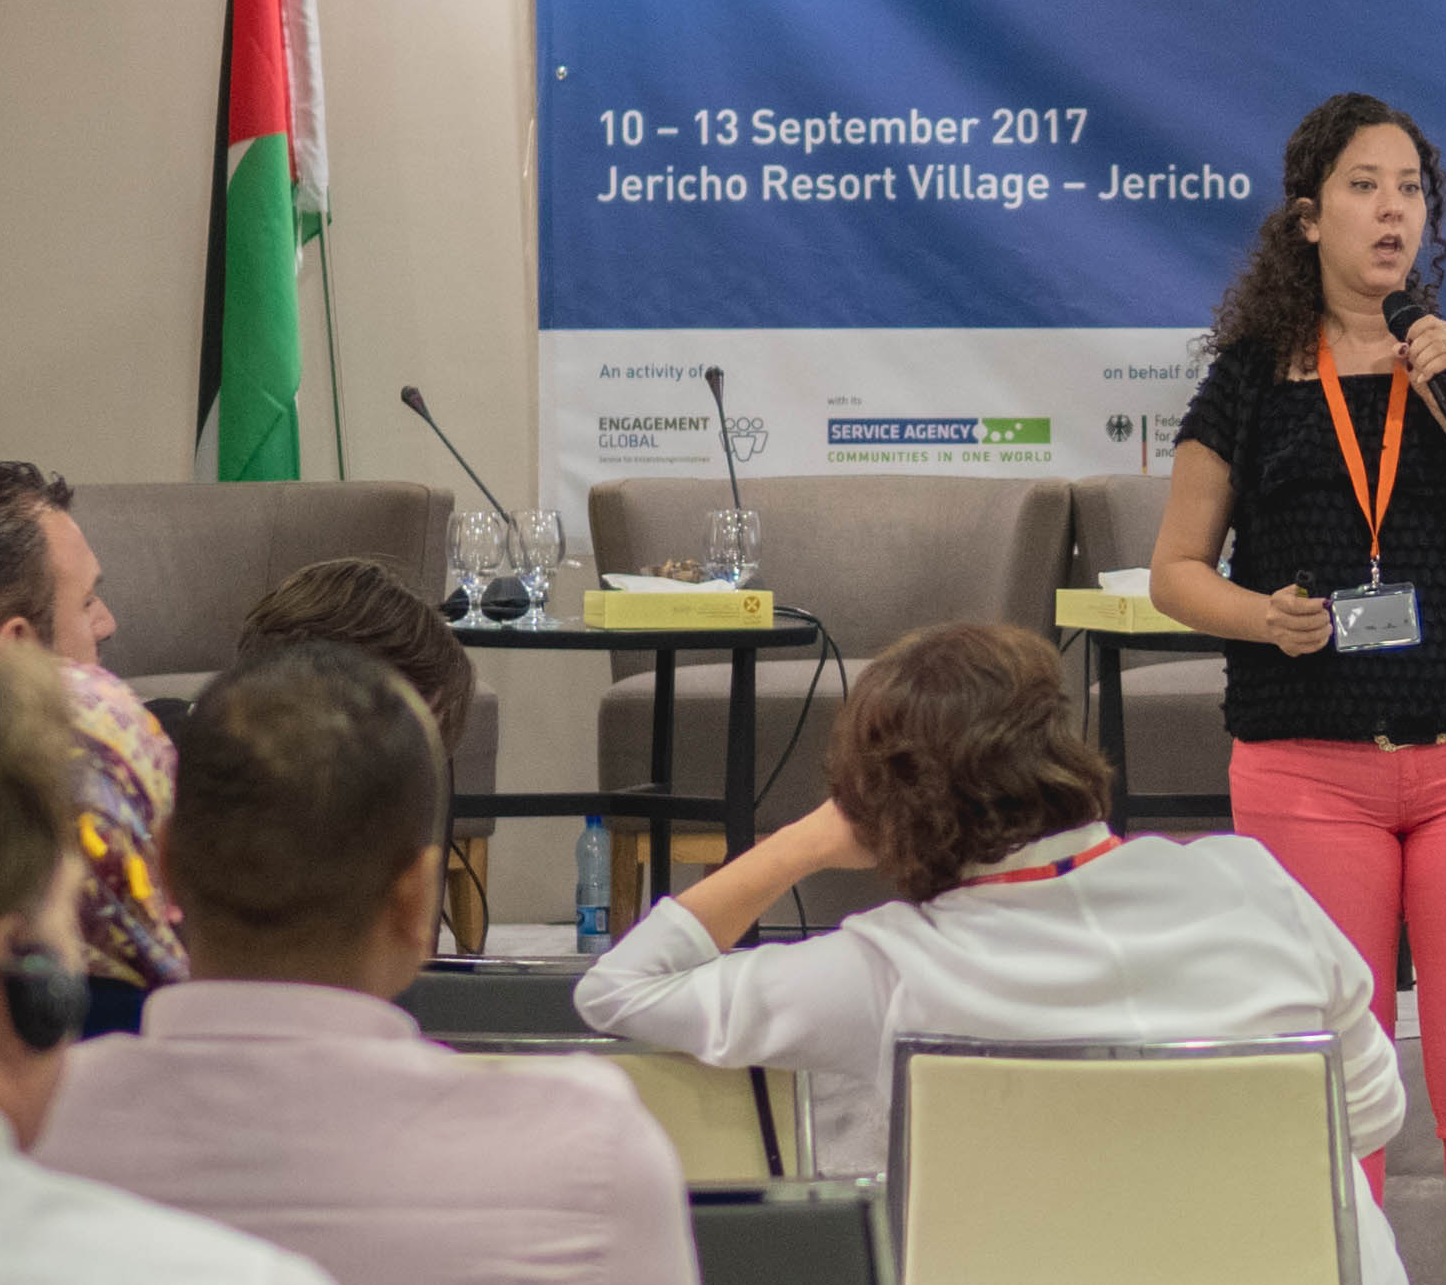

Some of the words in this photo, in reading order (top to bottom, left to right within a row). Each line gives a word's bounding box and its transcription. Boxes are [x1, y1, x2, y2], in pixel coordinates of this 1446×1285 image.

[600, 109, 644, 146] 10
[694, 108, 739, 146] 13
[751, 108, 981, 154] September
[992, 108, 1088, 145] 2017
[597, 165, 748, 202] Jericho
[762, 164, 896, 201] Resort
[909, 163, 1050, 210] Village
[1098, 164, 1252, 201] Jericho
[599, 364, 621, 380] An
[626, 364, 684, 382] activity
[688, 364, 703, 380] of
[1103, 368, 1123, 380] on
[1128, 365, 1181, 380] behalf
[1185, 365, 1201, 380] of
[827, 396, 849, 406] with
[598, 417, 710, 431] ENGAGEMENT
[1154, 414, 1181, 427] Fede
[831, 424, 900, 440] SERVICE
[904, 424, 972, 440] AGENCY
[598, 433, 659, 449] GLOBAL
[826, 451, 929, 463] COMMUNITIES
[937, 451, 953, 463] IN
[961, 451, 991, 463] ONE
[999, 450, 1053, 463] WORLD
